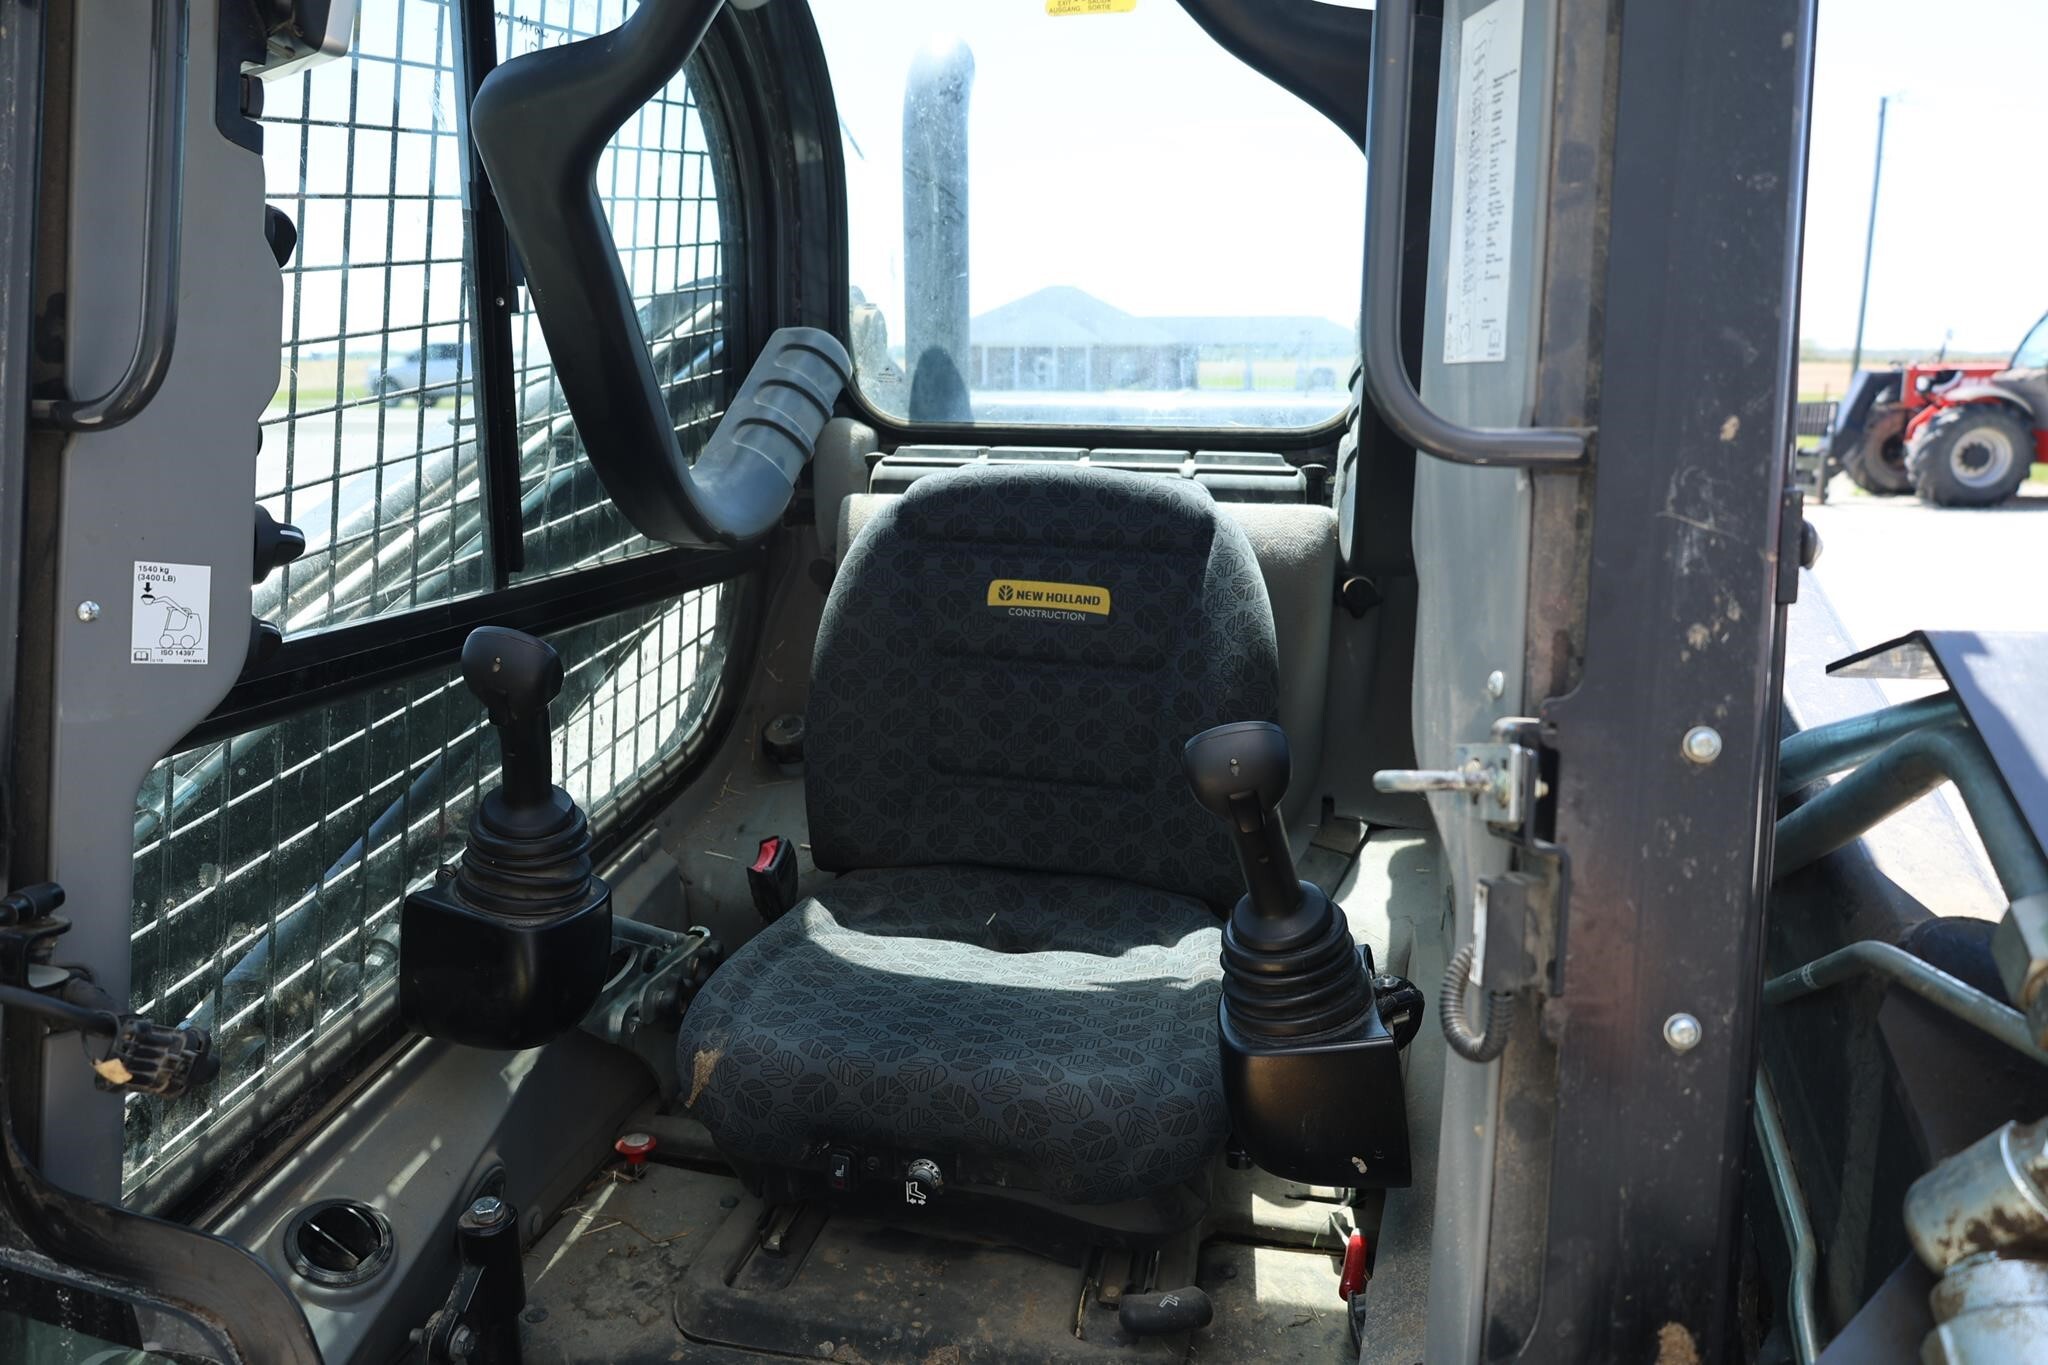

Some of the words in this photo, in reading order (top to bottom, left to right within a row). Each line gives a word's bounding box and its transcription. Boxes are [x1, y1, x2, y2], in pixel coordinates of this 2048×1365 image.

[1048, 6, 1081, 14] AUSGANG
[139, 565, 158, 573] 1540
[160, 566, 170, 575] kg
[138, 573, 161, 581] (3400
[163, 574, 177, 584] LB)
[1016, 590, 1044, 602] NEW
[1046, 592, 1101, 606] HOLLAND
[1008, 607, 1086, 621] CONSTRUCTION
